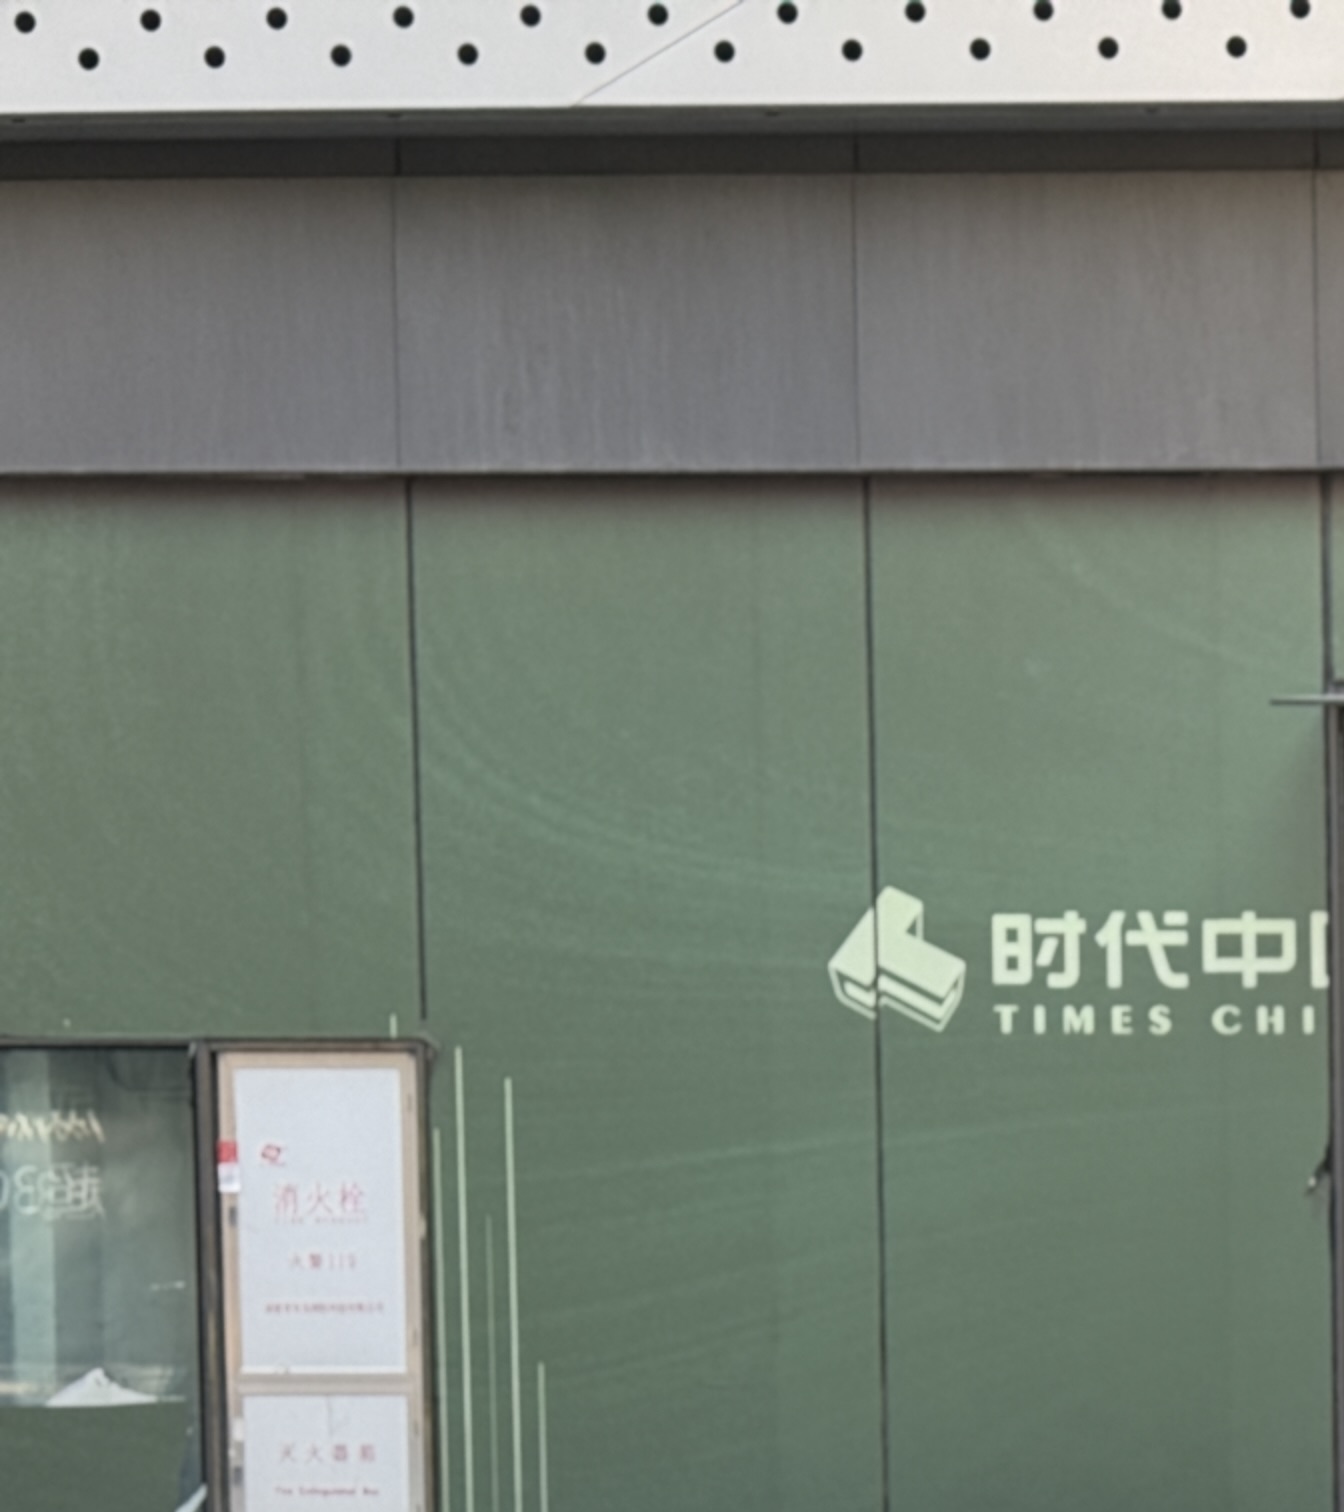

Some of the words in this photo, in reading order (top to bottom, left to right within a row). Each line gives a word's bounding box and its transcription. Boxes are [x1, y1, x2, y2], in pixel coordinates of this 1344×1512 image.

[991, 910, 1329, 989] 时代中
[993, 1004, 1173, 1035] TIMES
